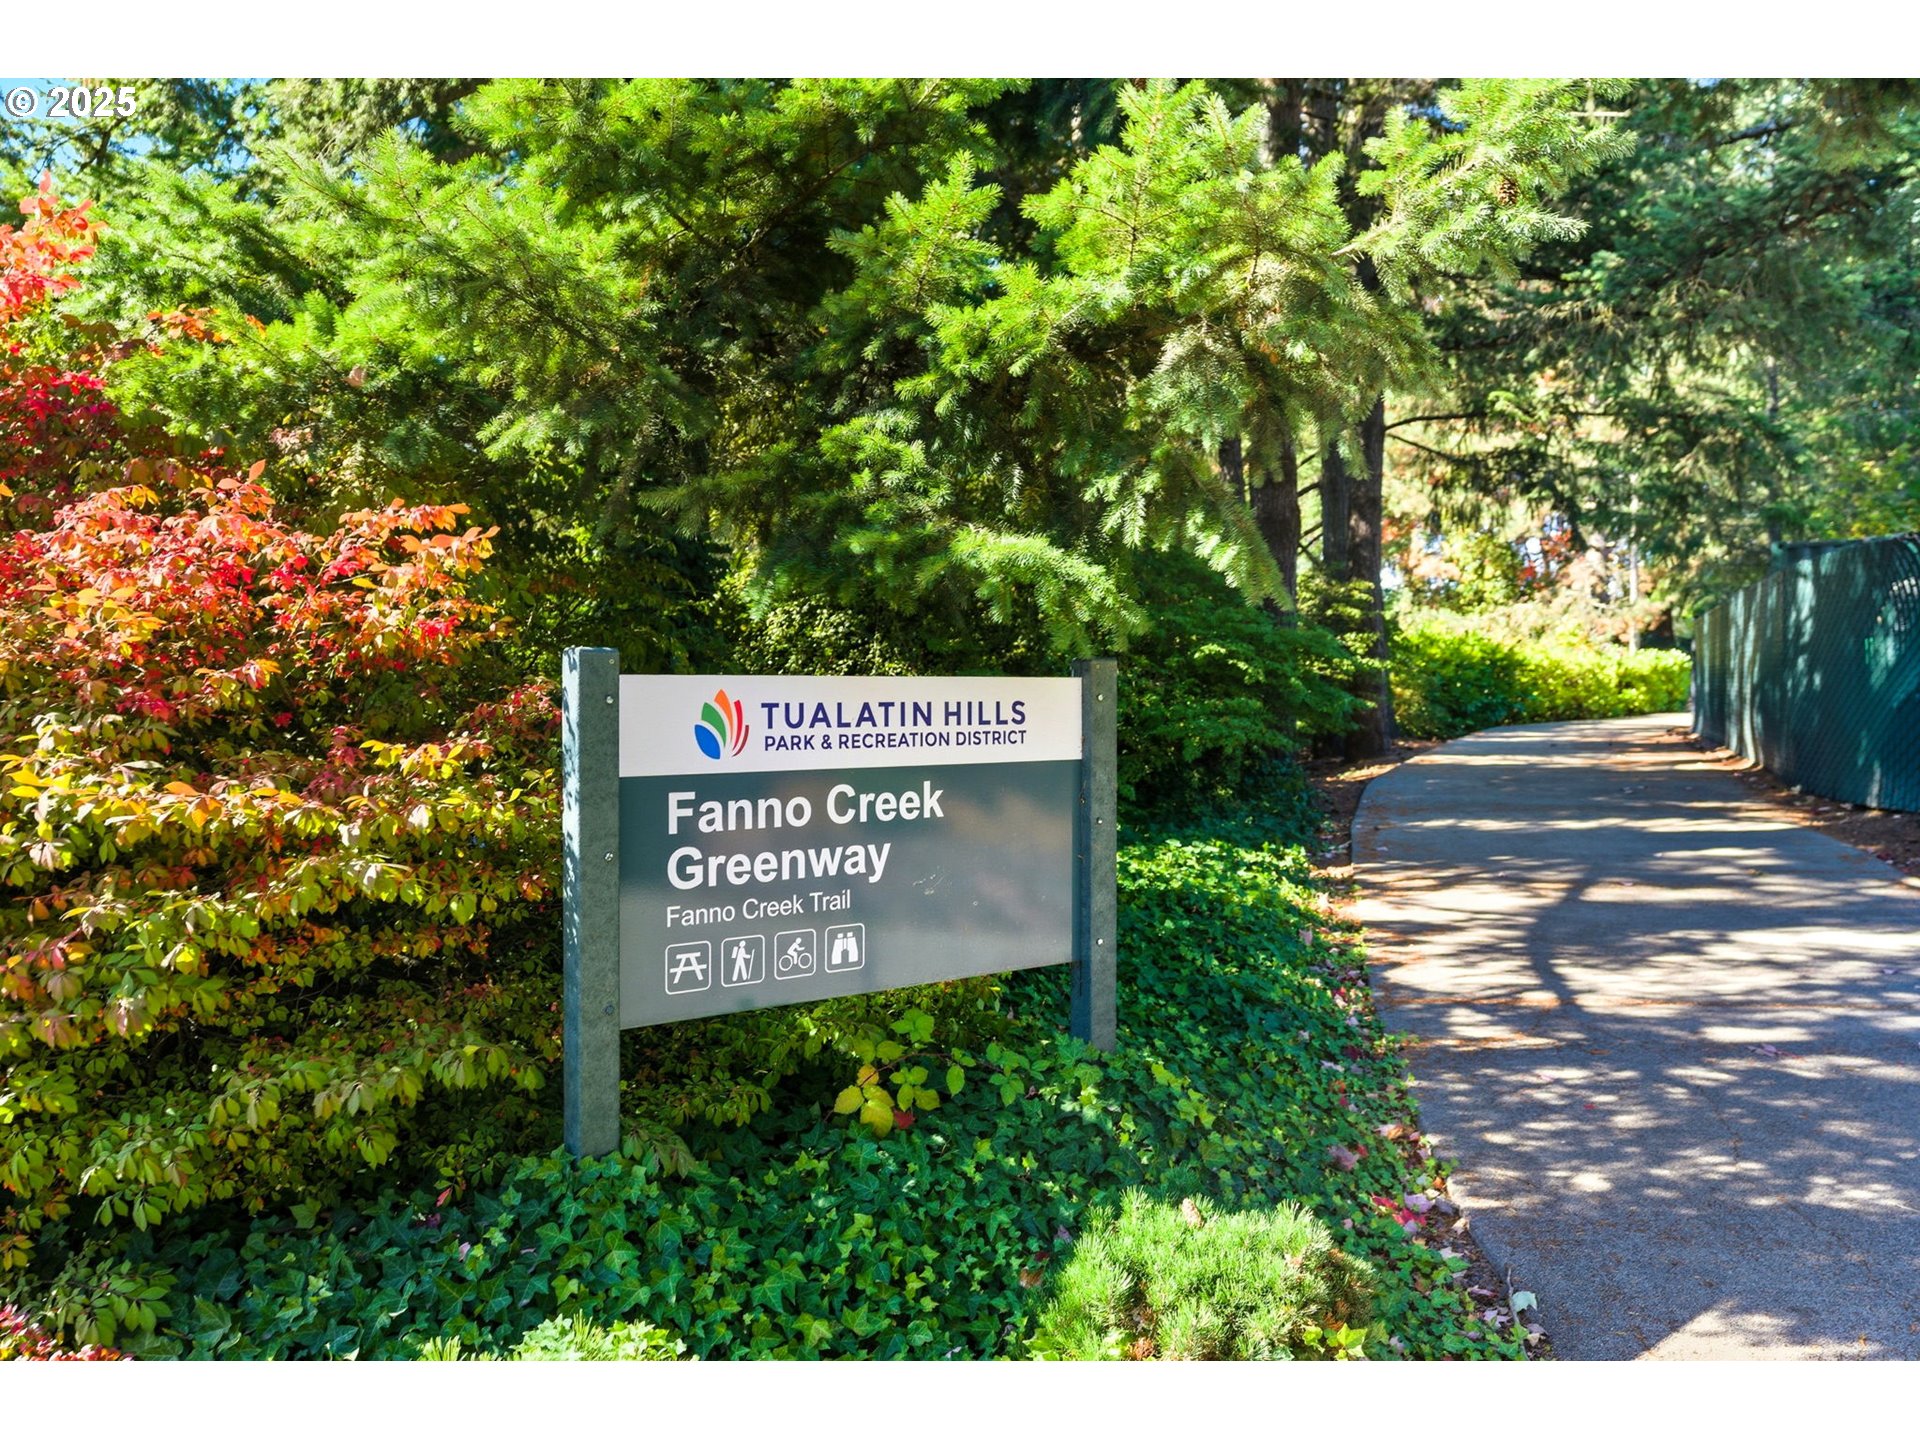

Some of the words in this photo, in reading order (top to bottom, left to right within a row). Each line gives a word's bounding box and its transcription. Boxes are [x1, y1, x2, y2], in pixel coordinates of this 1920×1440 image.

[761, 701, 933, 730] TUALATIN
[943, 700, 1027, 727] HILLS
[764, 733, 815, 752] PARK
[820, 733, 833, 751] &
[839, 731, 950, 750] RECREATION
[956, 729, 1027, 747] DISTRICT
[667, 790, 812, 835] Fanno
[826, 780, 944, 824] Creek
[667, 842, 891, 890] Greenway
[666, 905, 736, 928] Fanno
[742, 894, 803, 919] Creek
[809, 889, 851, 913] Trail
